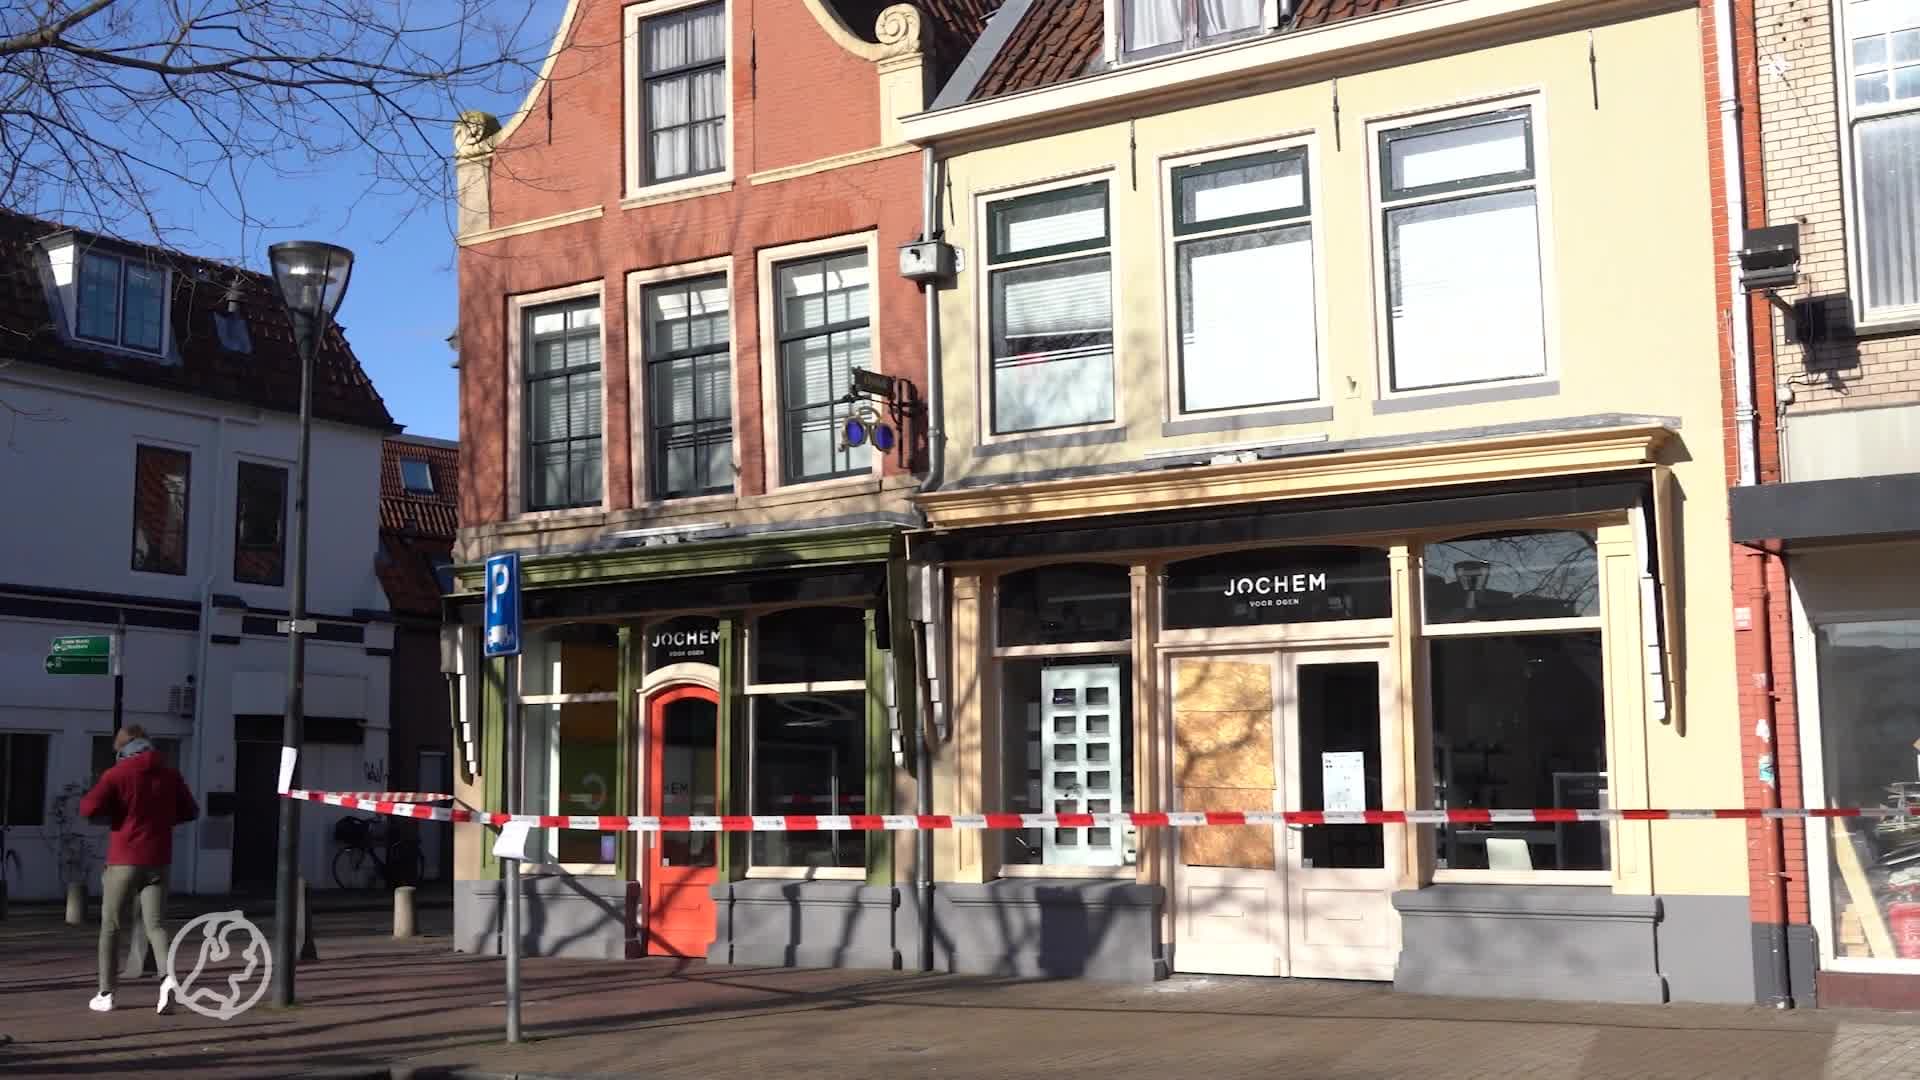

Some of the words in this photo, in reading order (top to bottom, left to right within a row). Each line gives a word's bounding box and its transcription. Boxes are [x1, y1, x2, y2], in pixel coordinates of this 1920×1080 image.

[492, 563, 510, 614] P
[1224, 573, 1326, 596] JOCHEM
[1249, 600, 1273, 608] VOOR
[652, 631, 721, 648] JOCHEM
